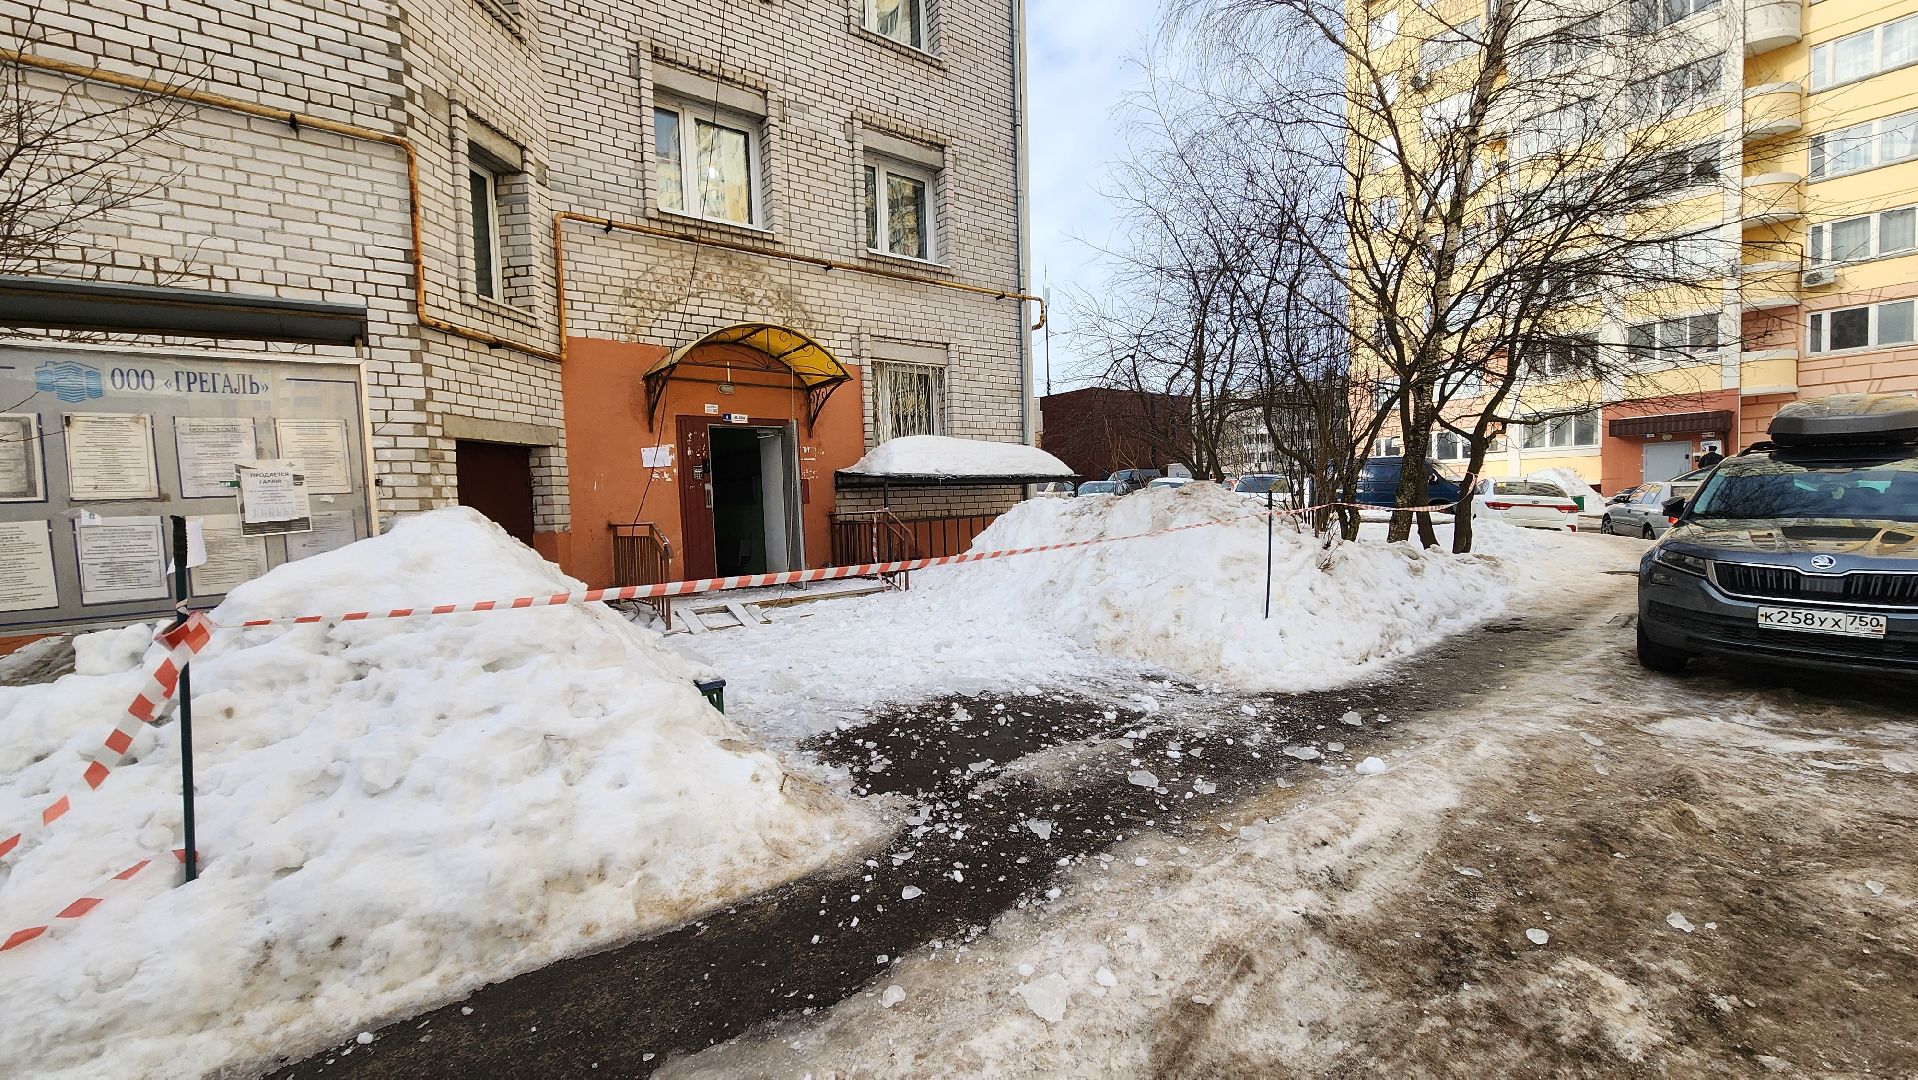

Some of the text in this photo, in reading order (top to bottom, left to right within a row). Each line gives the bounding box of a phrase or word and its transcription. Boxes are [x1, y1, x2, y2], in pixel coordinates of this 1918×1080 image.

[110, 367, 269, 395] ООО «ГРЕГАЛЬ»
[1847, 615, 1880, 628] 750
